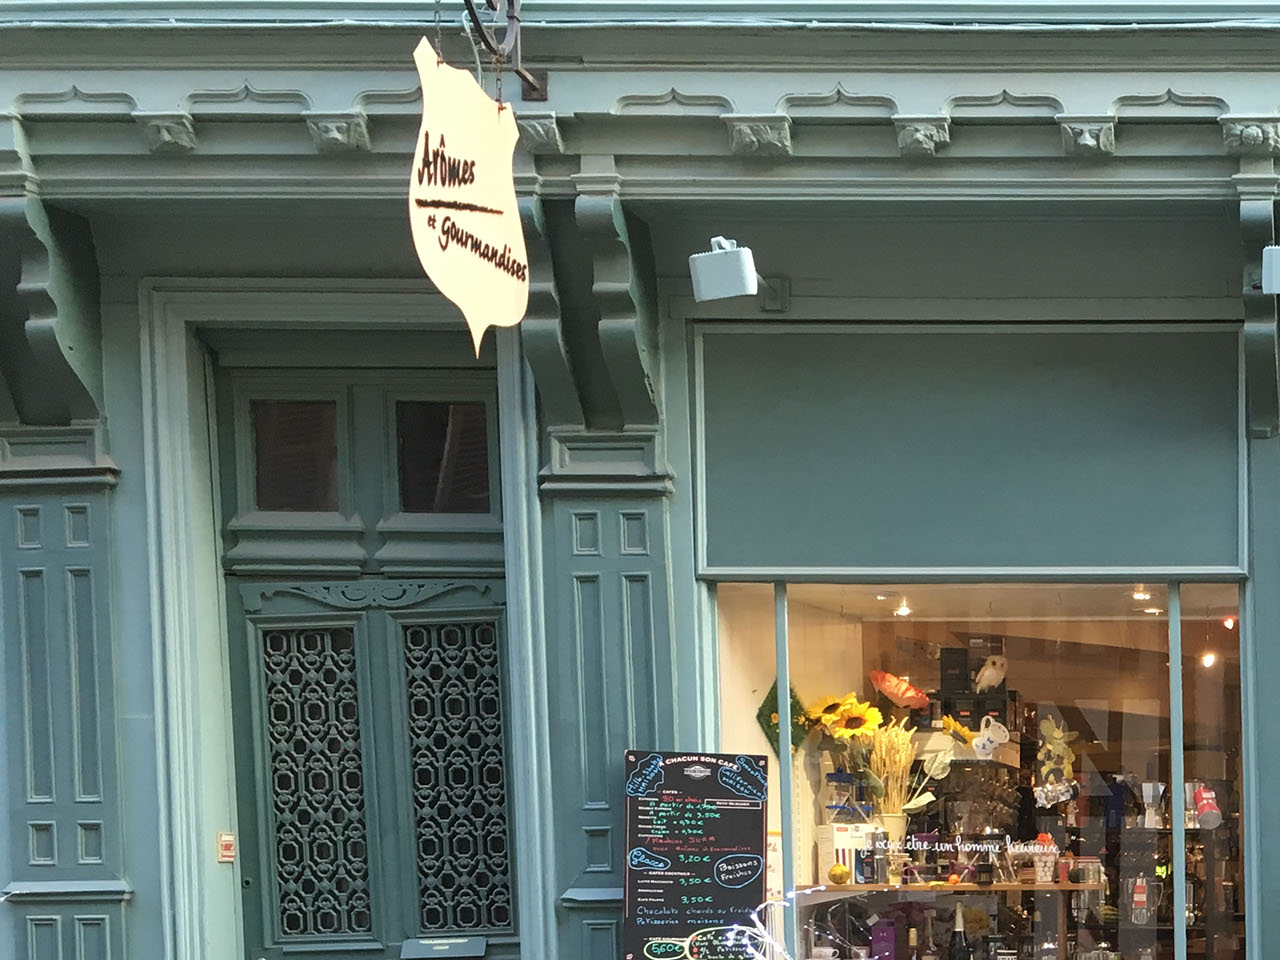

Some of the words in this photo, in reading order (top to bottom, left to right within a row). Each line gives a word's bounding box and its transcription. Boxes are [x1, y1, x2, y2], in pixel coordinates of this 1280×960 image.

[418, 130, 475, 187] Arômes
[428, 214, 437, 229] et
[438, 216, 527, 282] Gourmandises
[666, 756, 698, 765] CHACUN
[700, 756, 717, 764] SON
[861, 839, 873, 858] je
[905, 836, 931, 850] être
[932, 839, 955, 853] un
[956, 835, 1001, 853] homme
[1005, 835, 1060, 854] heureux
